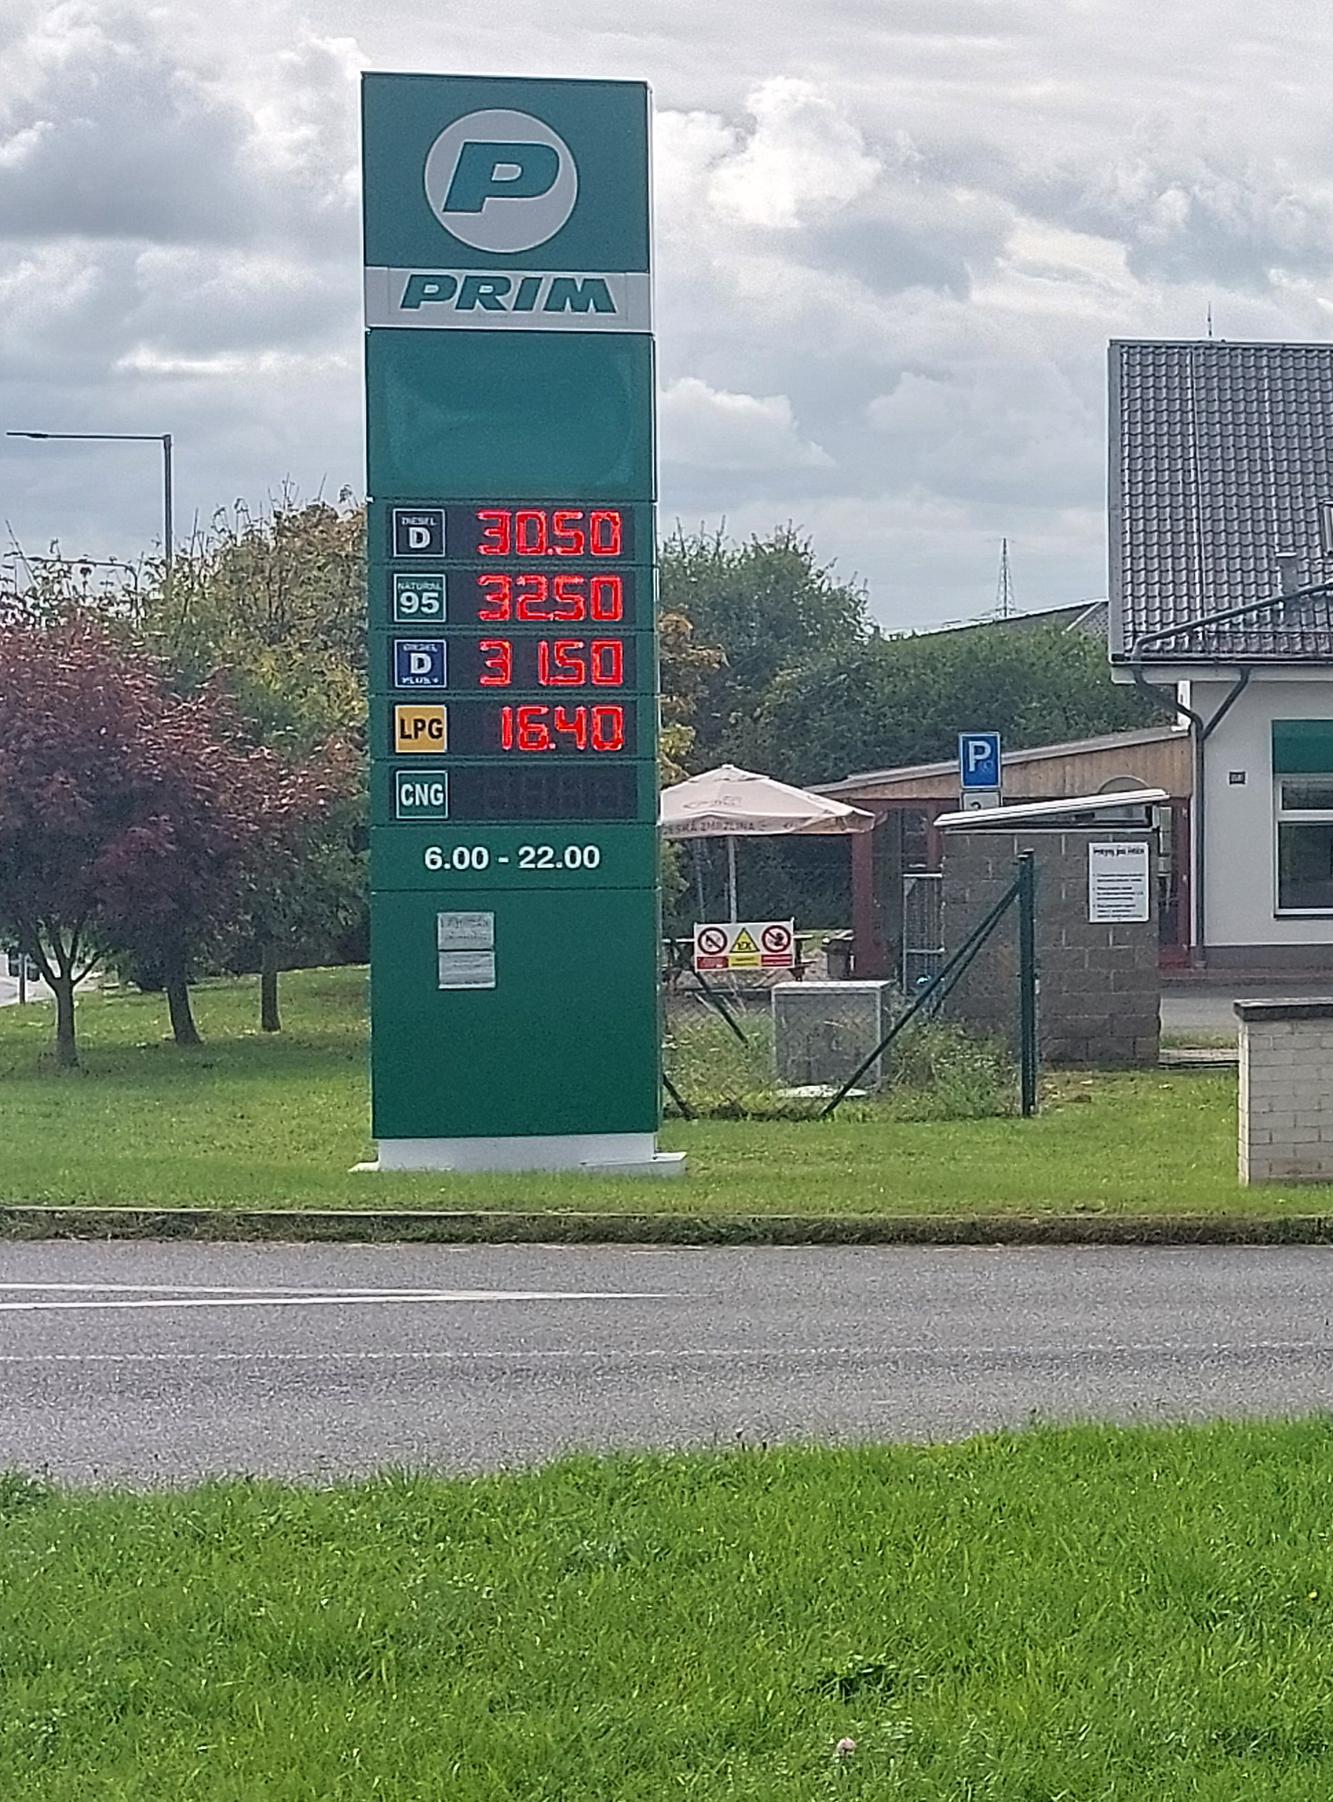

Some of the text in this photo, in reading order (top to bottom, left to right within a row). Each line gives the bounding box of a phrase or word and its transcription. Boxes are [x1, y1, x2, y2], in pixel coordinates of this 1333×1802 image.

[443, 141, 560, 213] P
[400, 274, 617, 314] PRIM
[408, 526, 431, 549] D
[478, 511, 622, 556] 30.50
[399, 591, 440, 614] 95
[410, 653, 432, 674] D
[400, 718, 444, 740] LPG
[501, 706, 625, 751] 16.40
[968, 740, 992, 773] P
[400, 783, 444, 806] CNG
[424, 846, 490, 870] 6.00
[518, 845, 601, 869] 22.00
